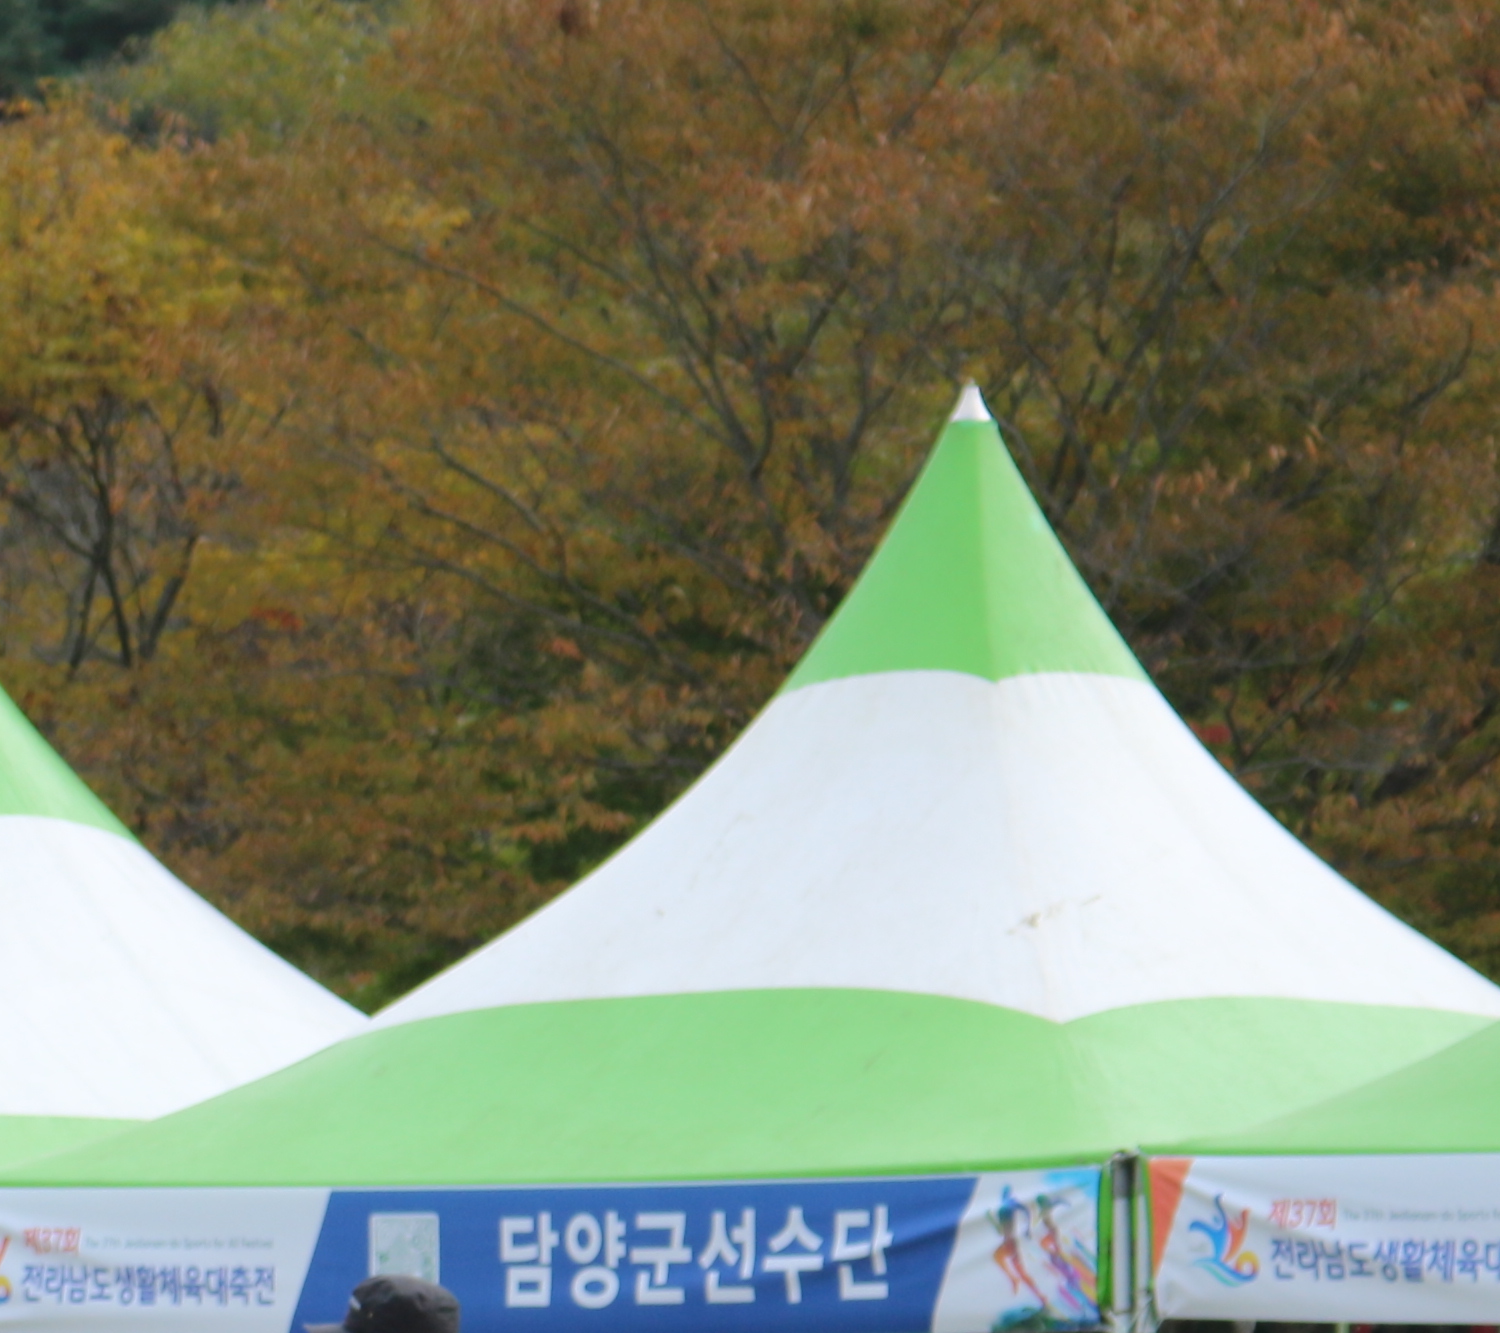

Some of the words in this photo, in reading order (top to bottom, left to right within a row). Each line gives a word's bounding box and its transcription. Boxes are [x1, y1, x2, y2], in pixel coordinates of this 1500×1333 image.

[1269, 1199, 1337, 1230] 제37회
[498, 1207, 894, 1311] 담양군선수단
[22, 1265, 277, 1305] 전라남도생활체육대축전
